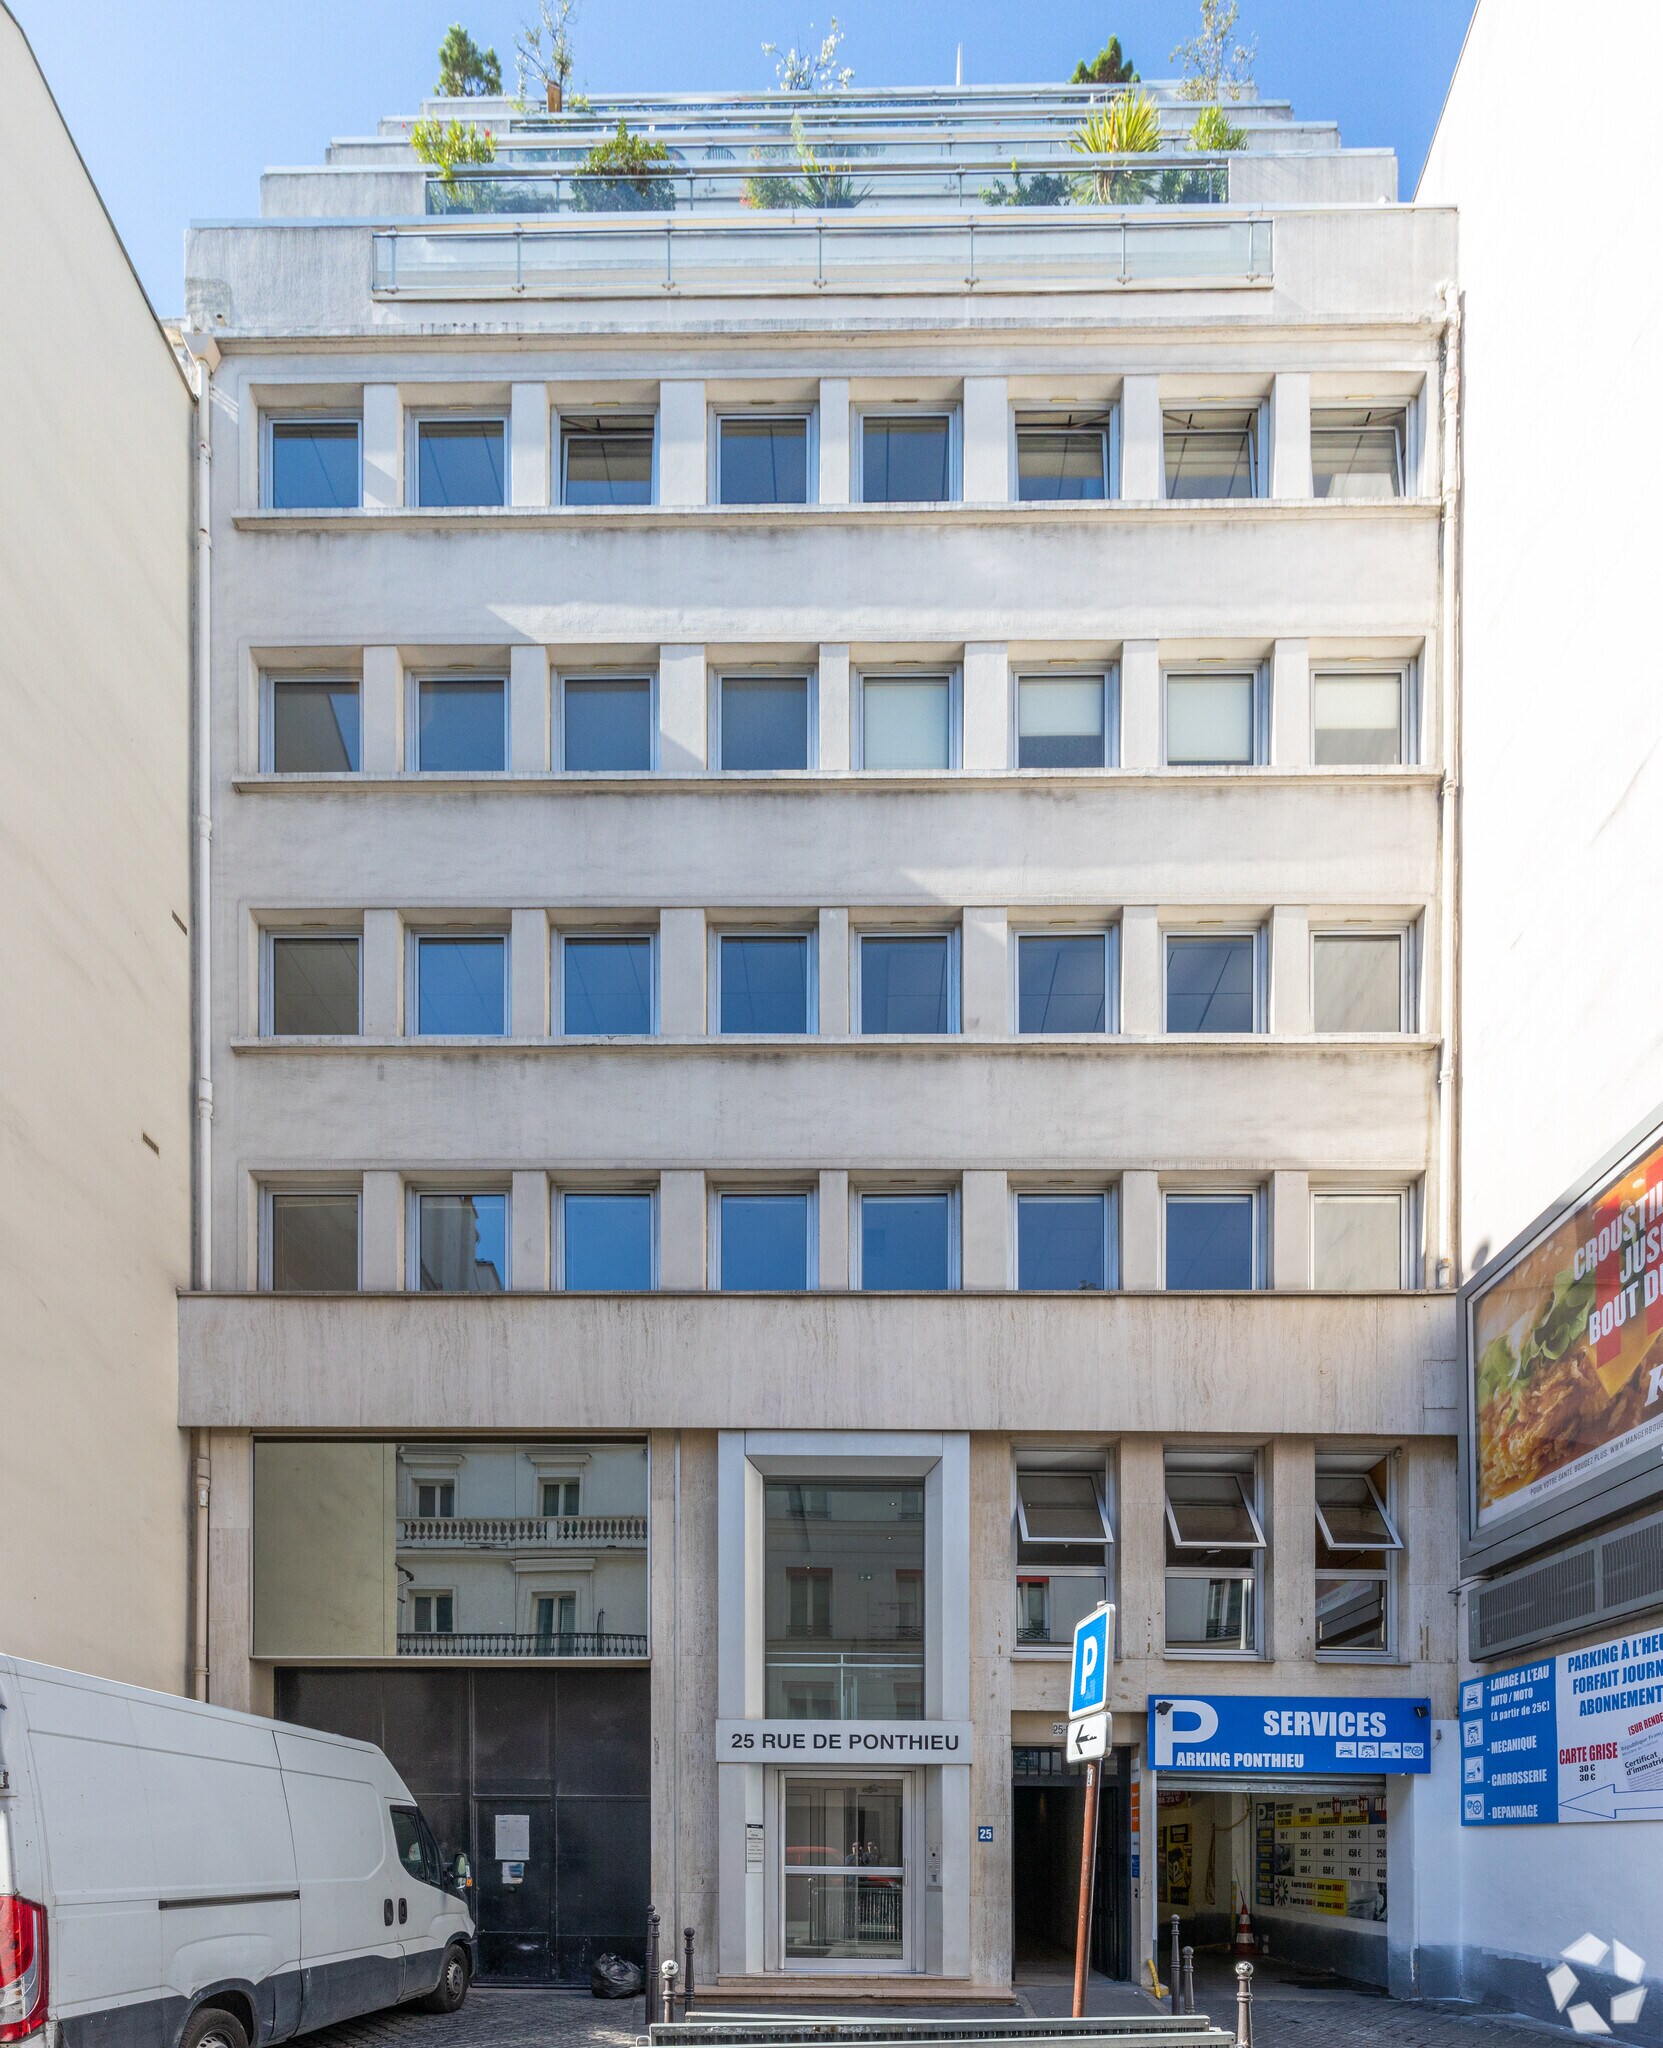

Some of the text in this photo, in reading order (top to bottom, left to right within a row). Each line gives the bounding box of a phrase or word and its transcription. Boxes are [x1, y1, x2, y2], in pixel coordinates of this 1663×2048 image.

[1620, 1222, 1663, 1284] JUS
[1589, 1264, 1663, 1346] BOUT D
[1530, 1485, 1543, 1496] POUR
[1543, 1478, 1557, 1489] VOTRE
[1574, 1460, 1593, 1473] BOUGEZ
[1081, 1635, 1098, 1695] P
[1568, 1645, 1618, 1673] PARKING
[1621, 1640, 1630, 1660] À
[1491, 1672, 1519, 1691] LAVAGE
[1520, 1671, 1526, 1684] A
[1527, 1665, 1550, 1682] L'EAU
[1573, 1659, 1663, 1695] FORFAIT JOURN
[1491, 1693, 1508, 1706] AUTO
[1513, 1687, 1533, 1701] MOTO
[1579, 1685, 1663, 1717] ABONNEMENT
[1499, 1708, 1520, 1721] partir
[1521, 1706, 1531, 1716] de
[1053, 1724, 1068, 1735] 25-
[1263, 1710, 1386, 1737] SERVICES
[731, 1733, 959, 1750] 25 RUE DE PONTHIEU
[1491, 1735, 1537, 1754] MECANIQUE
[1234, 1753, 1304, 1768] PONTHIEU
[1559, 1745, 1587, 1765] CARTE
[1589, 1742, 1618, 1761] GRISE
[1624, 1752, 1658, 1768] Certificat
[1492, 1769, 1547, 1786] CARROSSERIE
[1579, 1764, 1596, 1773] 30 €
[1579, 1773, 1596, 1782] 30 €
[1492, 1804, 1538, 1819] DEPANNAGE
[979, 1828, 992, 1840] 25
